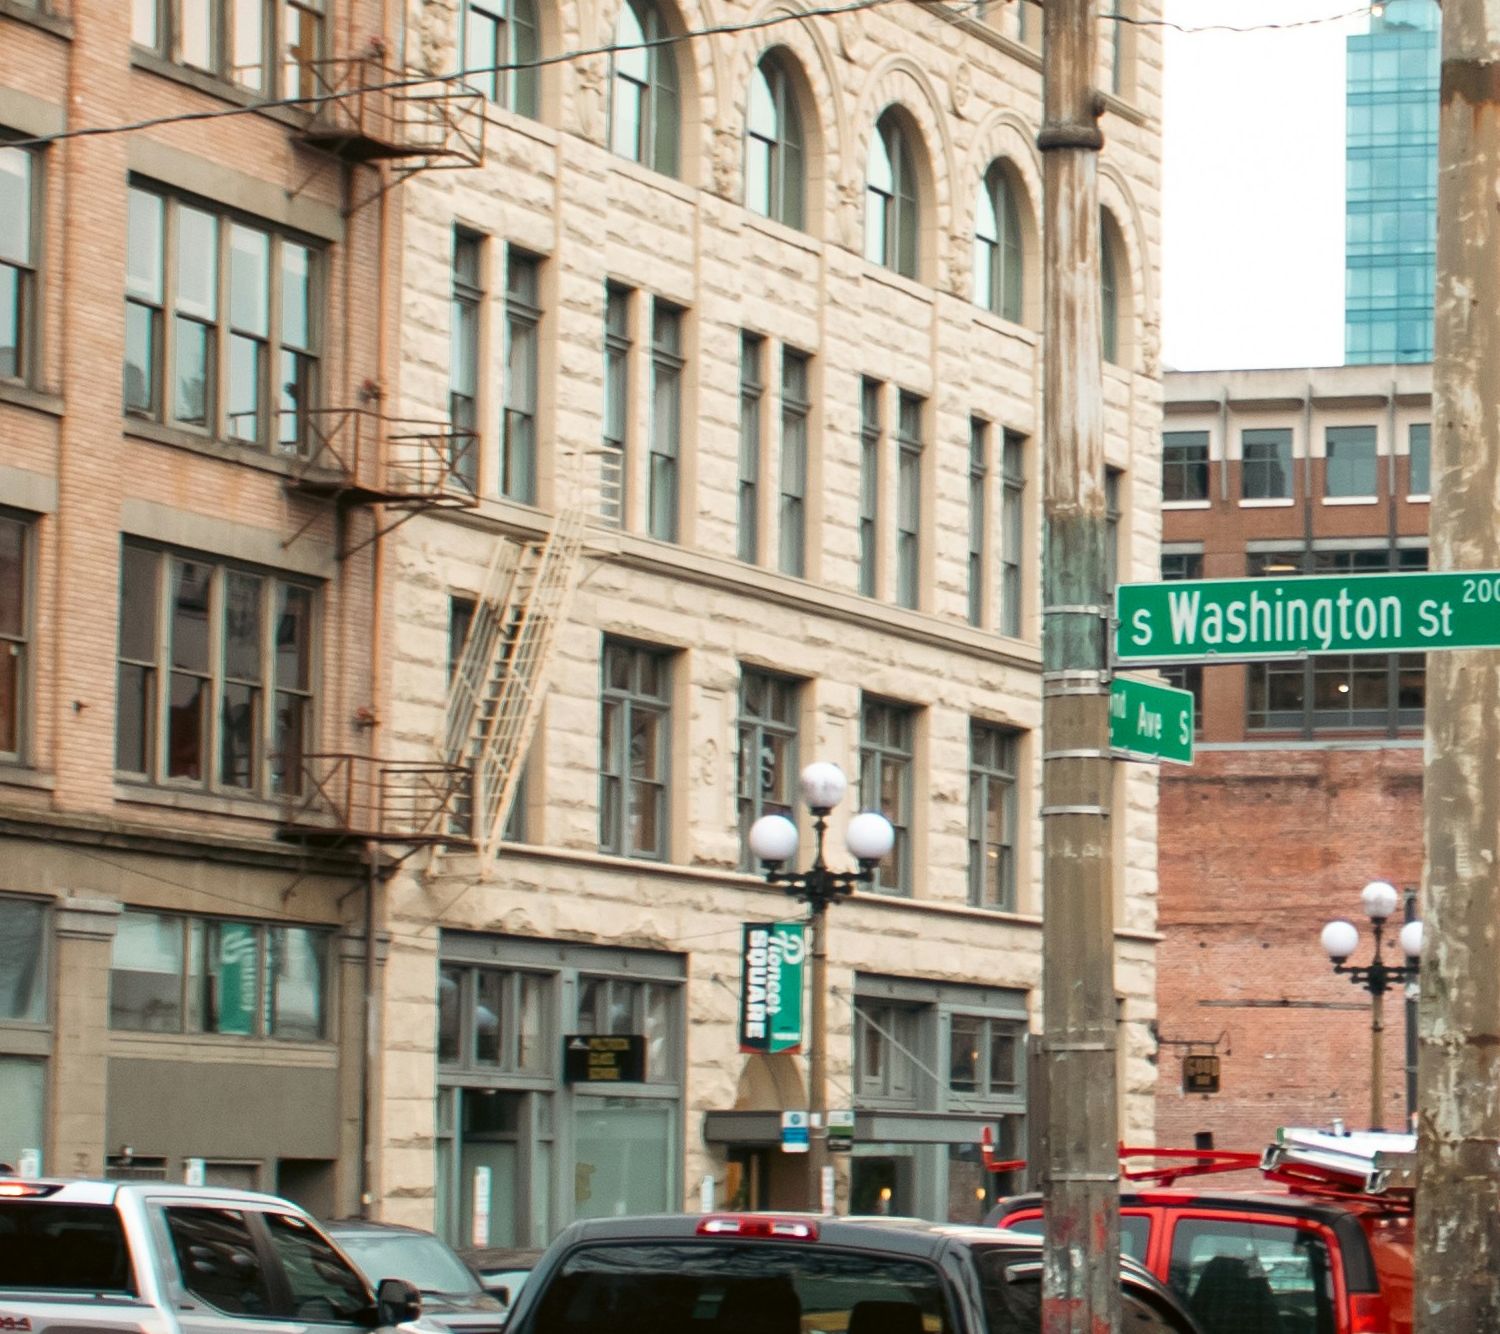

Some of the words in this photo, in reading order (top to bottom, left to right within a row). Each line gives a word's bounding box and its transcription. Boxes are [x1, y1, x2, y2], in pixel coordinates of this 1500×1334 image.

[1131, 608, 1154, 647] S
[1167, 587, 1402, 651] Washington
[1417, 599, 1454, 638] St
[1137, 701, 1163, 741] Ave
[1178, 709, 1190, 746] S
[745, 930, 769, 1039] SQUARE
[766, 931, 806, 1017] Pioneer
